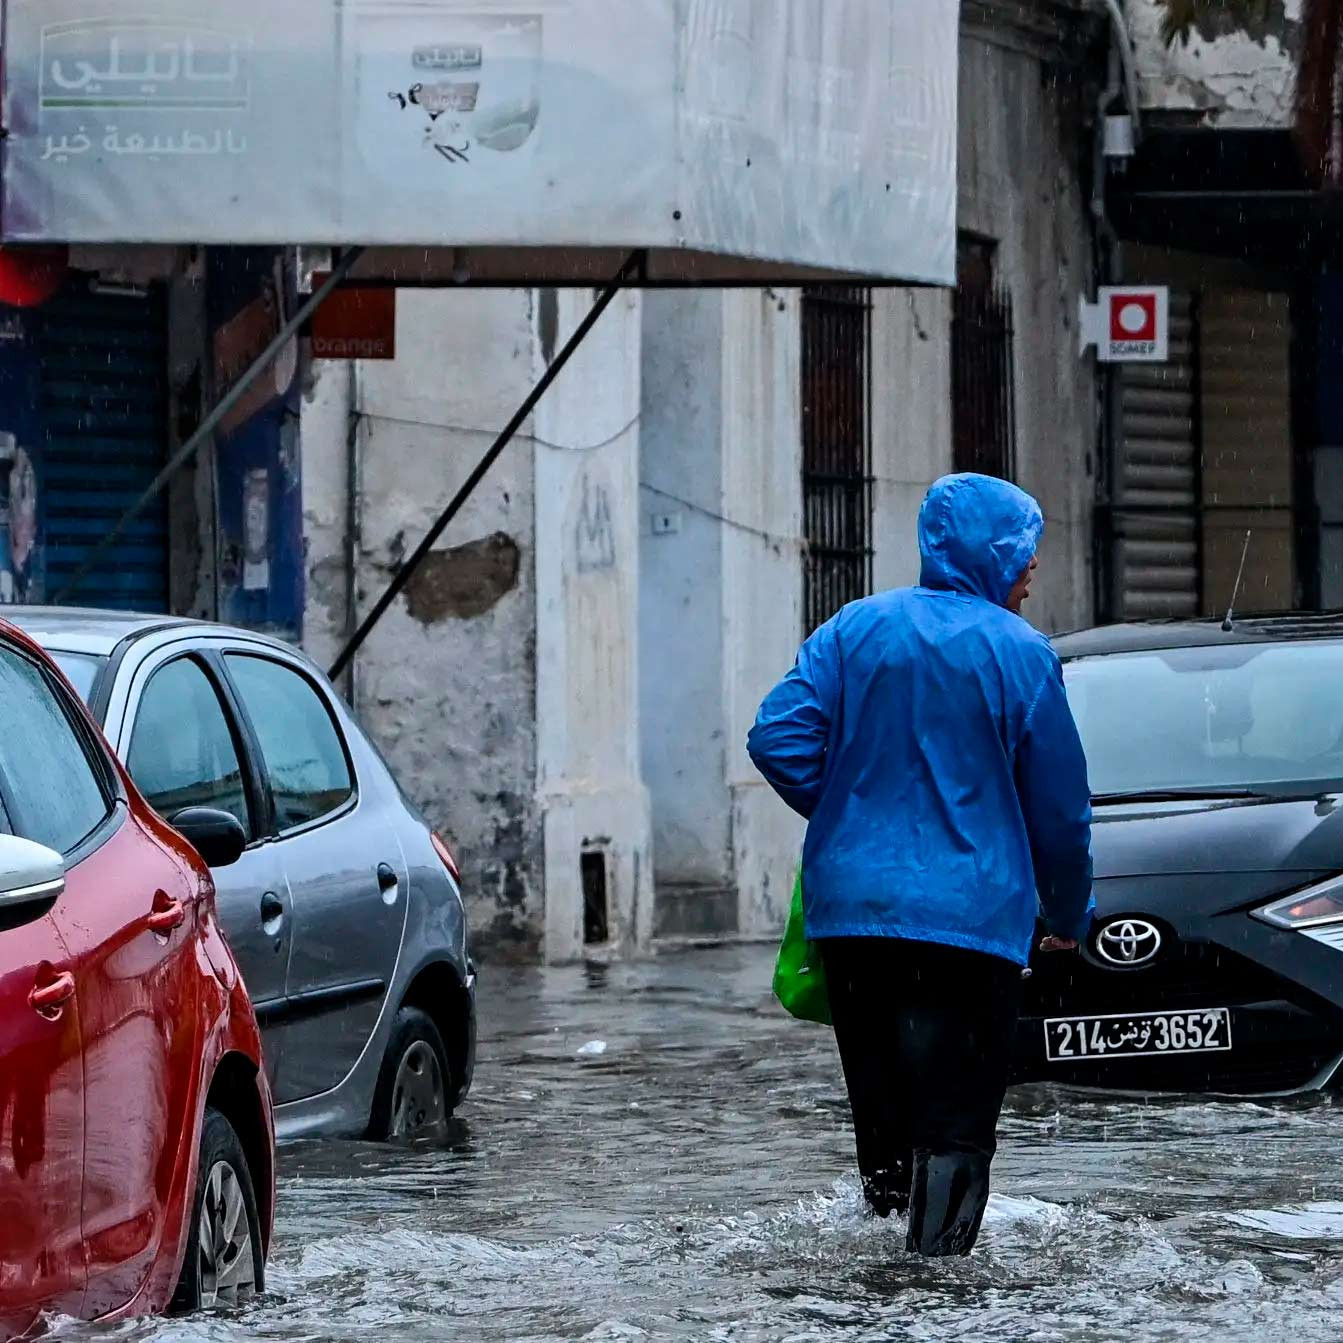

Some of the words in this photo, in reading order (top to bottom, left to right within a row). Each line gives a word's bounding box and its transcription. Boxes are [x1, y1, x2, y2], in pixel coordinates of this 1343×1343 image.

[40, 125, 91, 162] خير
[313, 338, 386, 356] orange
[1056, 1021, 1107, 1056] 214
[1107, 1021, 1151, 1049] تونس
[1153, 1014, 1220, 1050] 3652
